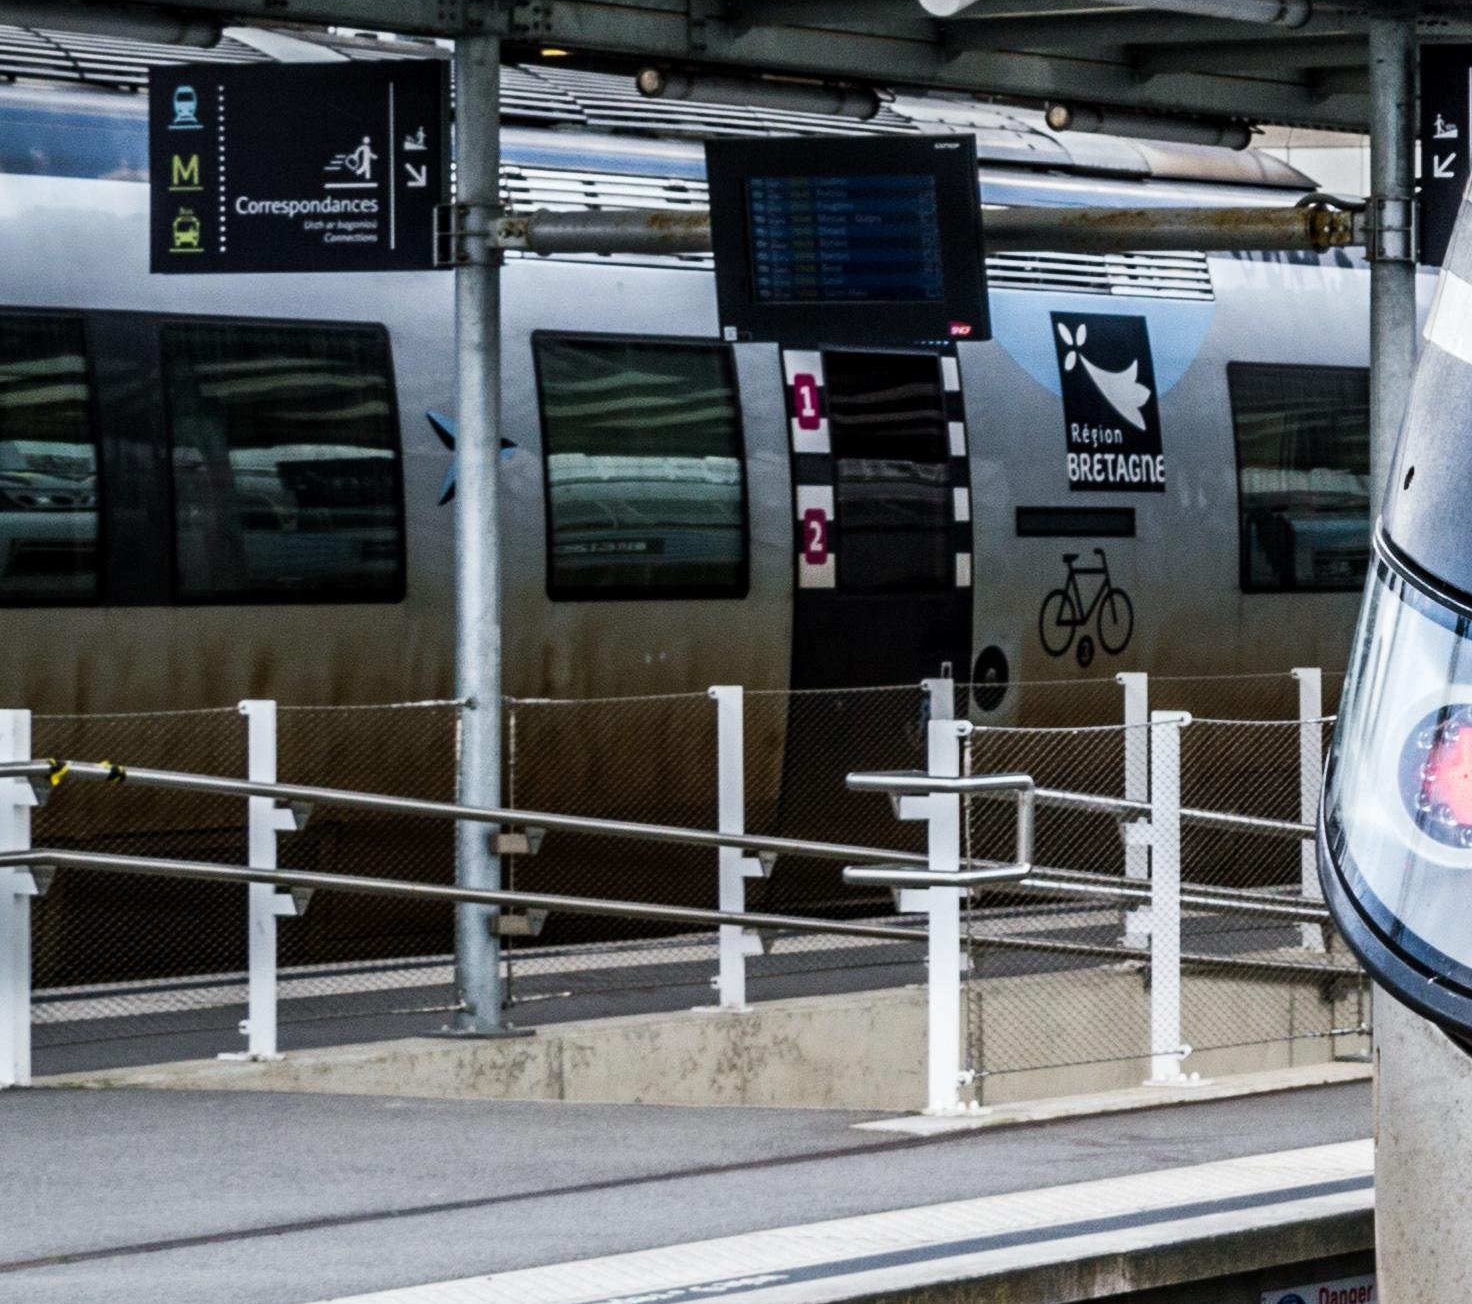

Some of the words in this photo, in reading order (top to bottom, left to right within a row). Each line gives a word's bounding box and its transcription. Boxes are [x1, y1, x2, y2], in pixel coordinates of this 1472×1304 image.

[172, 154, 199, 185] M
[236, 196, 378, 217] Correspondances
[800, 386, 815, 417] 1
[1071, 423, 1123, 447] Région
[1067, 453, 1165, 482] BRETAGNE
[810, 520, 823, 552] 2
